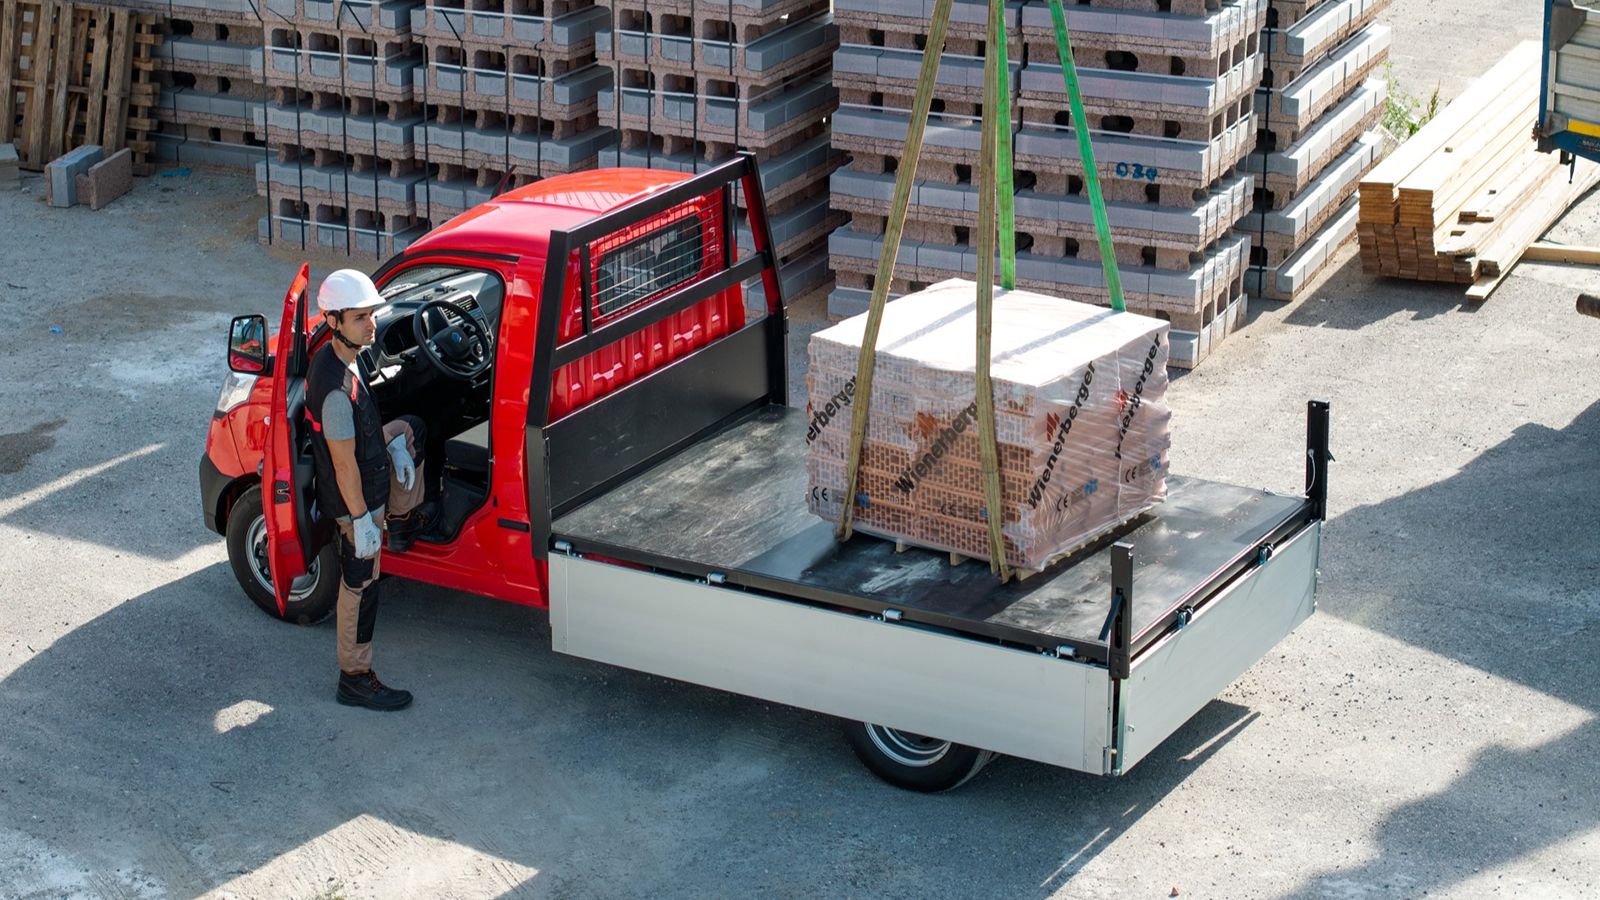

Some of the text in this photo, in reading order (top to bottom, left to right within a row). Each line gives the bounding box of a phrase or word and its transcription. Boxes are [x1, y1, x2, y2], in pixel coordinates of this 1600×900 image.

[1028, 360, 1096, 510] Wienerberger
[1125, 466, 1137, 483] CE
[813, 486, 829, 502] CE
[1056, 493, 1068, 512] CE
